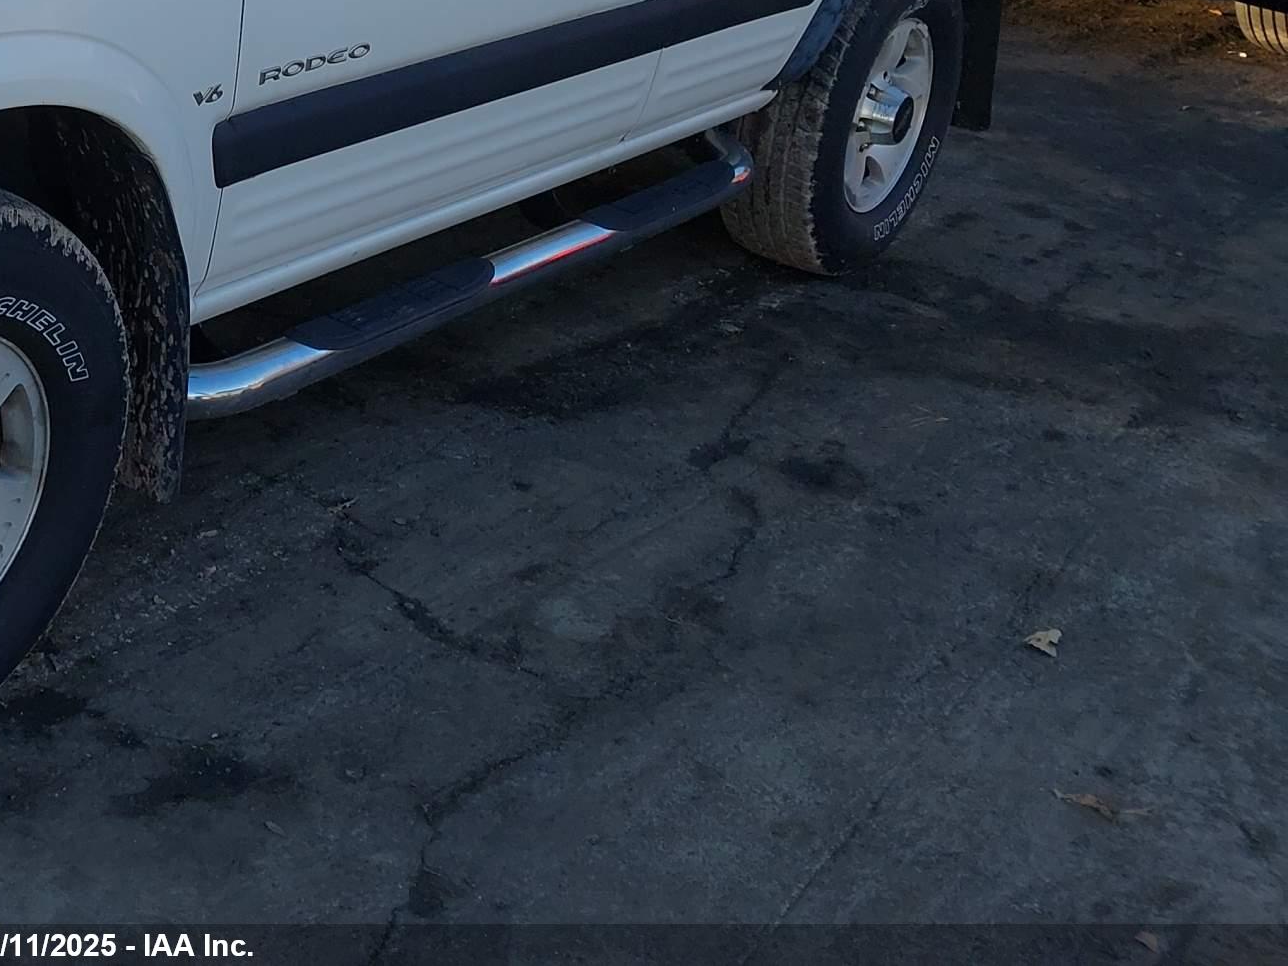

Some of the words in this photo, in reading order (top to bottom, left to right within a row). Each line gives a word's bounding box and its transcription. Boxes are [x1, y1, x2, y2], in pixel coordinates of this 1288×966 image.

[258, 42, 372, 86] RODEO
[192, 83, 224, 107] V6
[873, 135, 940, 241] MICHELIN
